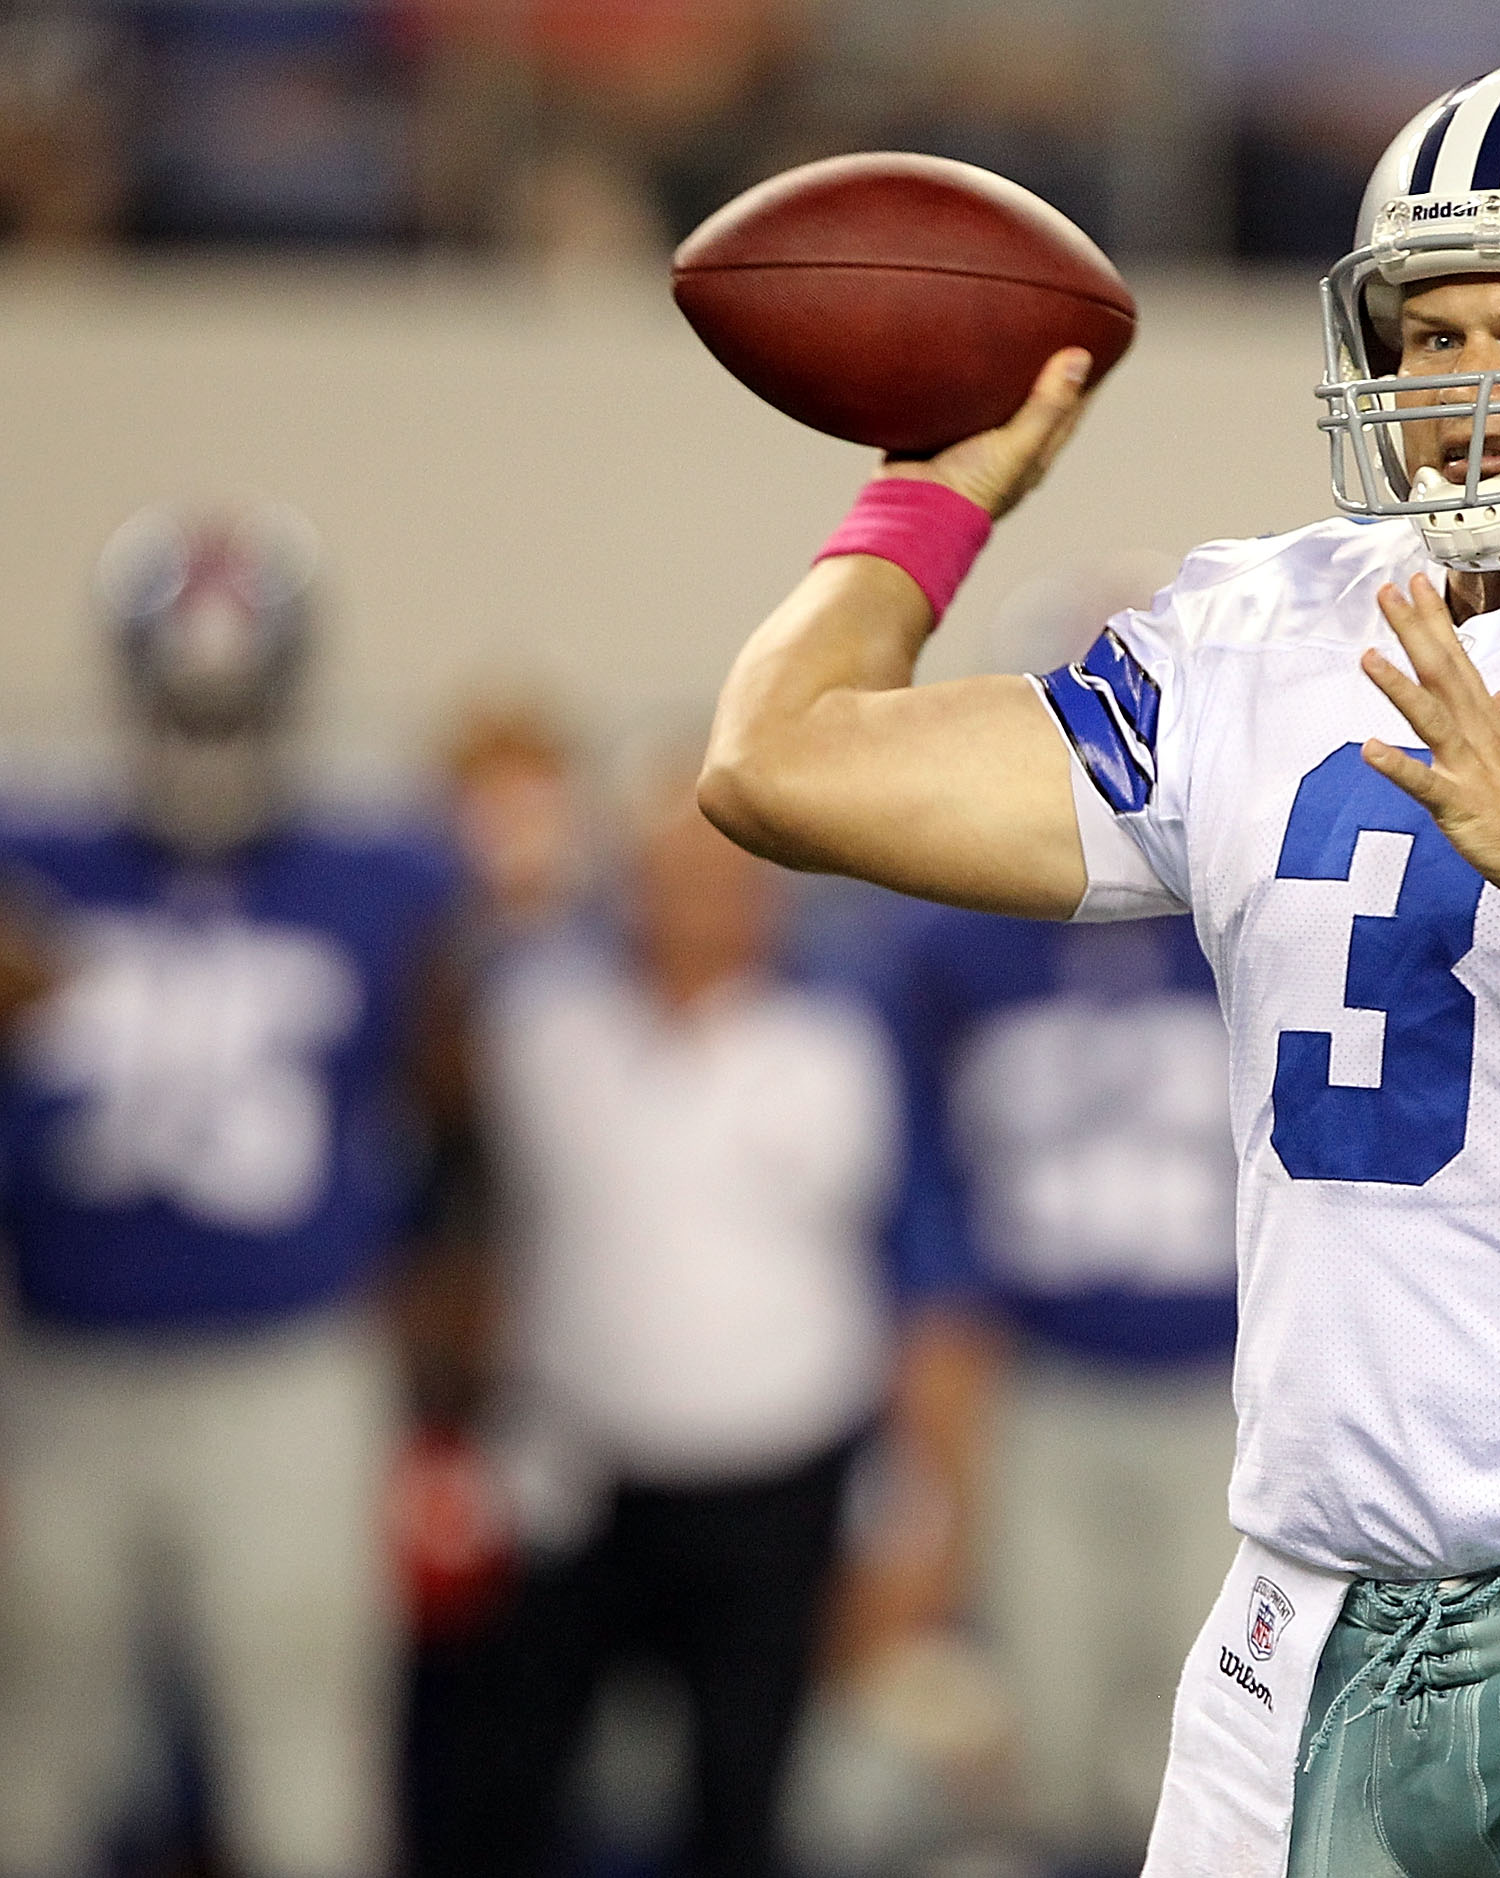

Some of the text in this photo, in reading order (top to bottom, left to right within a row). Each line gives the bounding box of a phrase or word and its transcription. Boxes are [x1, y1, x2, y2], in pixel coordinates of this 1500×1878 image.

[1270, 741, 1486, 1186] 3
[1252, 1618, 1272, 1649] NFL
[1219, 1646, 1274, 1713] Wilson
